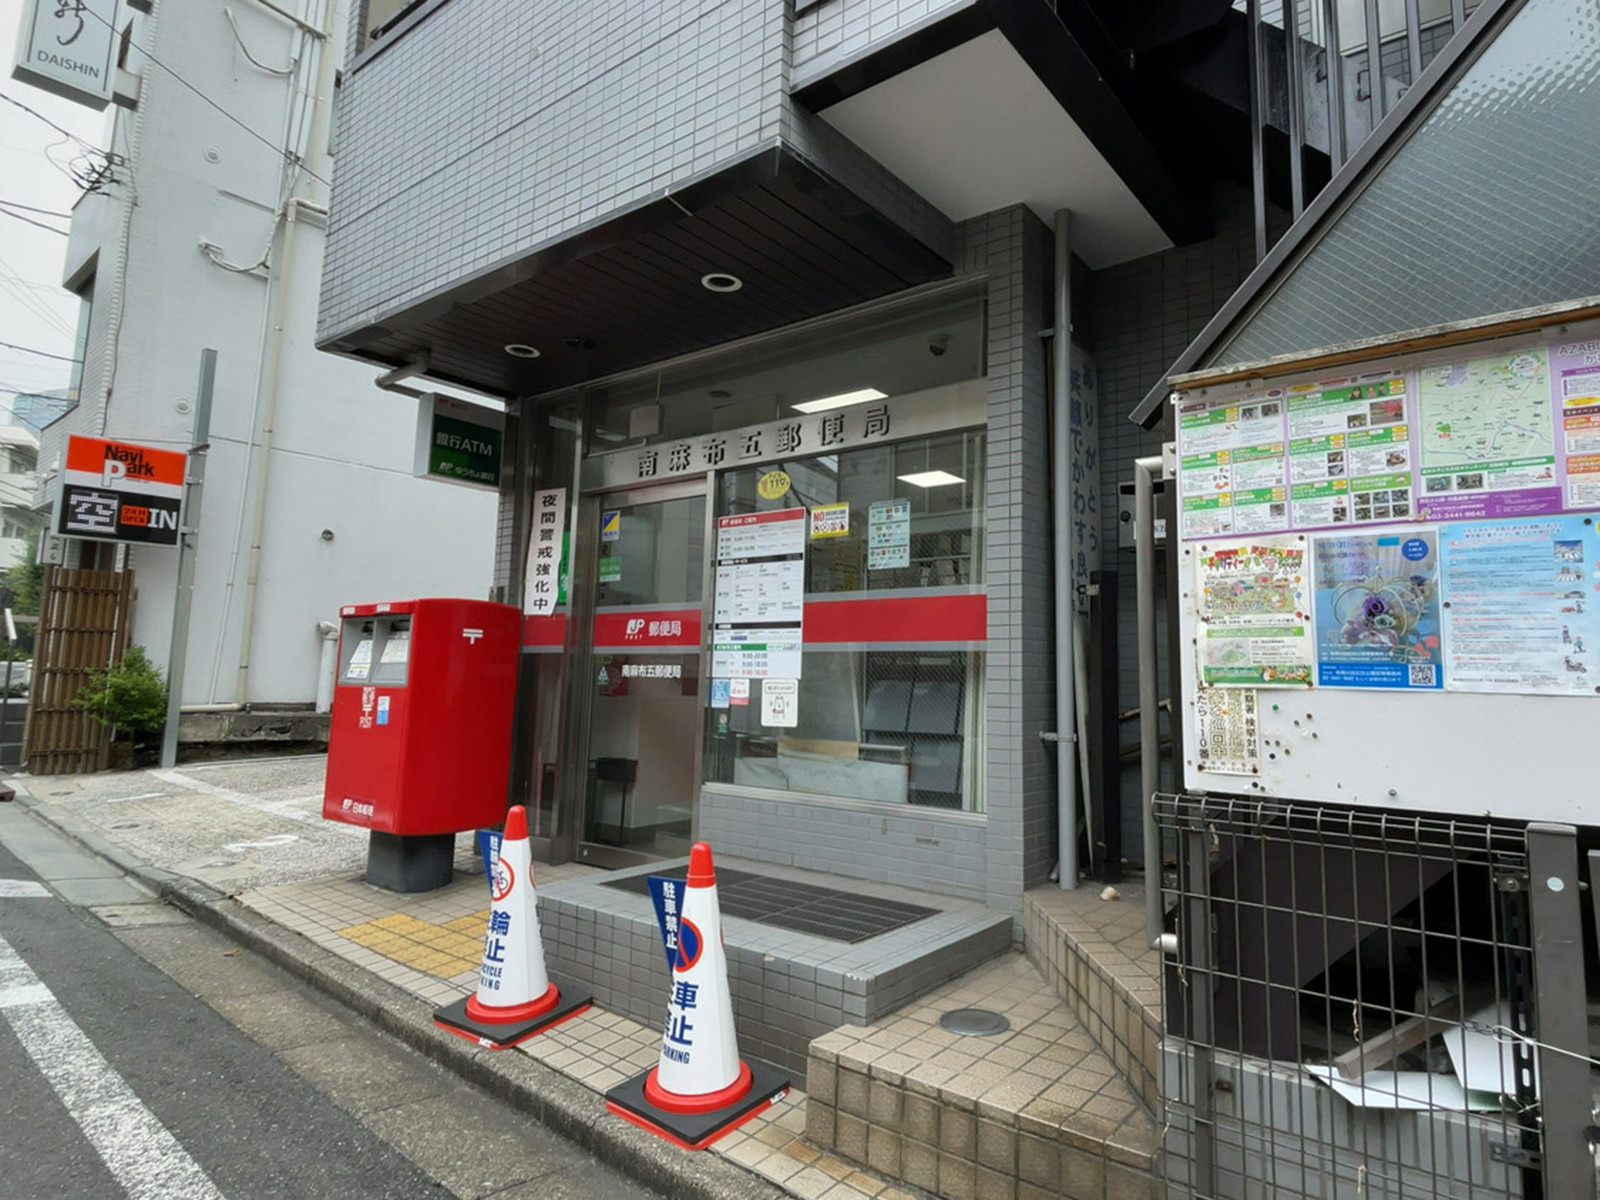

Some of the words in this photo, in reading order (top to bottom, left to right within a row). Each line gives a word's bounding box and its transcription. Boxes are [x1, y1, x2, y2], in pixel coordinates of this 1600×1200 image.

[37, 50, 100, 79] DAISHIN
[105, 445, 145, 463] Navi
[436, 431, 493, 457] 銀行ATM
[637, 404, 891, 478] 南麻布五郵便局
[102, 459, 155, 487] Park
[67, 492, 118, 533] 空
[148, 508, 178, 530] IN
[533, 494, 558, 611] 夜間警戒強化中
[648, 620, 682, 637] 郵便局
[621, 664, 682, 679] 南麻布五郵便局
[488, 909, 511, 936] 輪
[662, 881, 678, 949] 駐車禁止
[484, 936, 506, 963] 止
[667, 980, 699, 1011] 車
